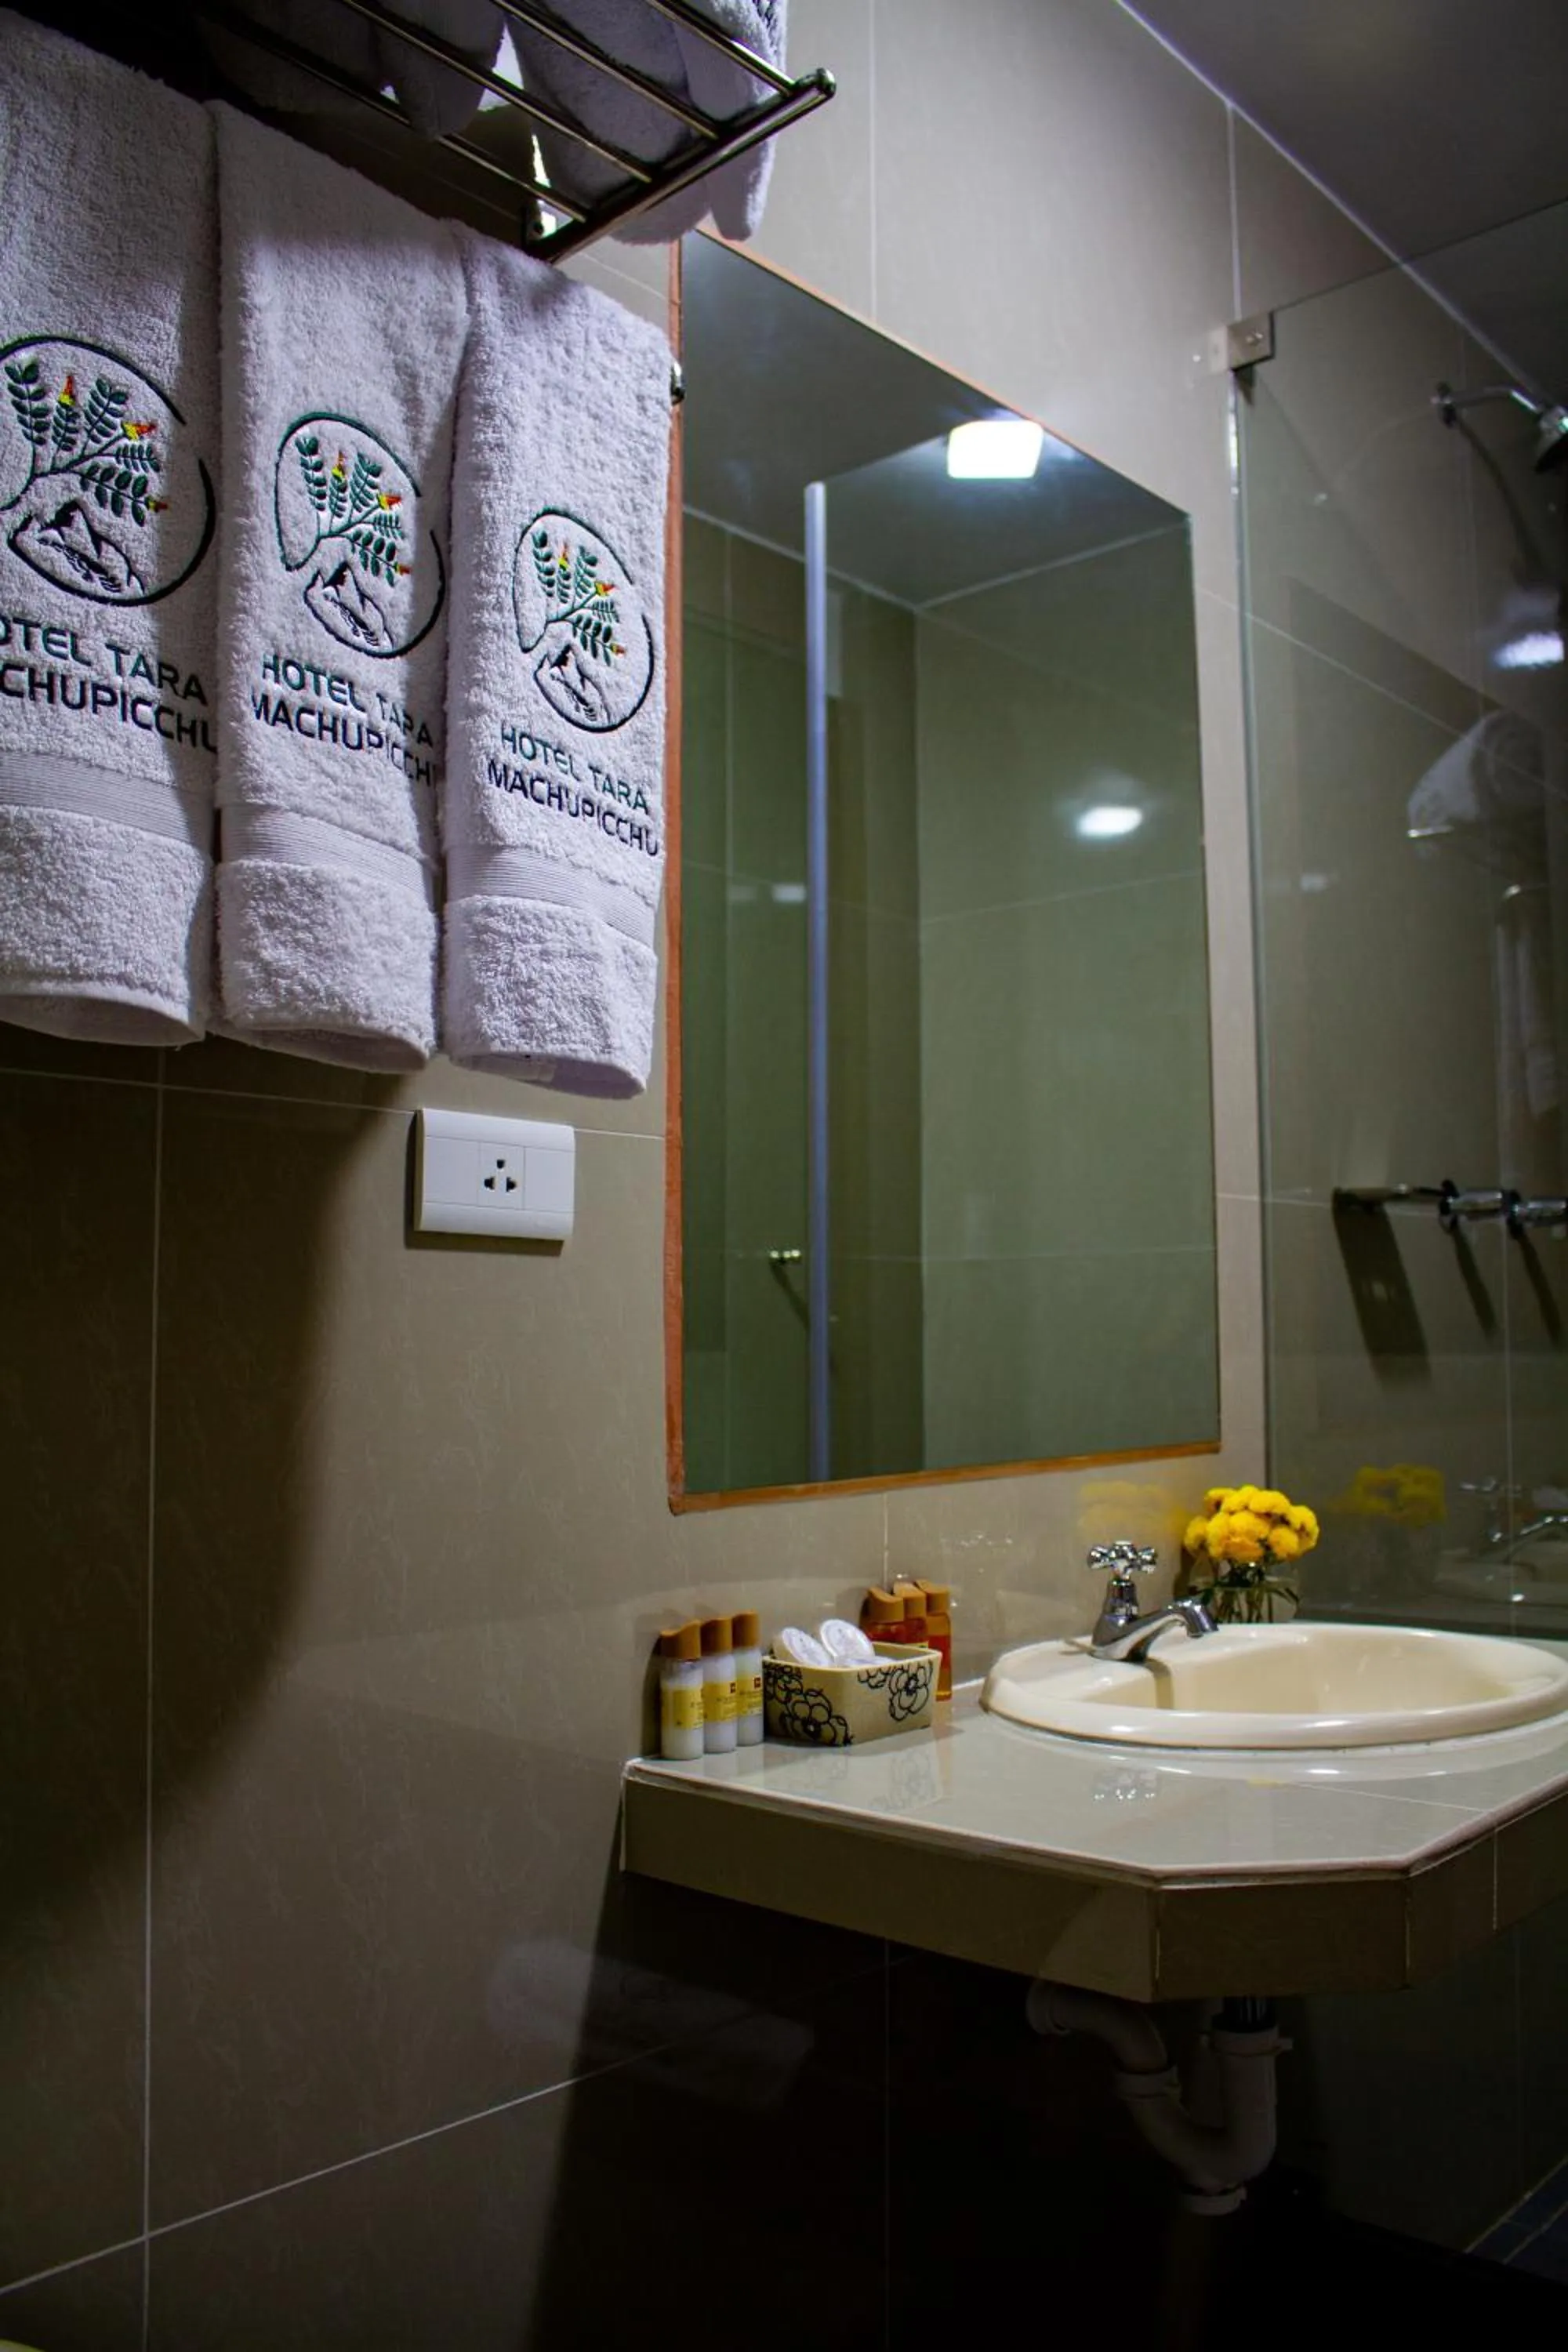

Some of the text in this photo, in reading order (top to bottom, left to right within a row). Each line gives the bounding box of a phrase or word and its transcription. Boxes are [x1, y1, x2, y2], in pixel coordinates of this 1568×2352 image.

[105, 643, 208, 706] TARA
[263, 653, 433, 748] HOTEL TARA
[251, 685, 436, 789] MACHUPICCH
[500, 720, 648, 815] HOTEL TARA
[488, 758, 659, 856] MACHUPICCHU
